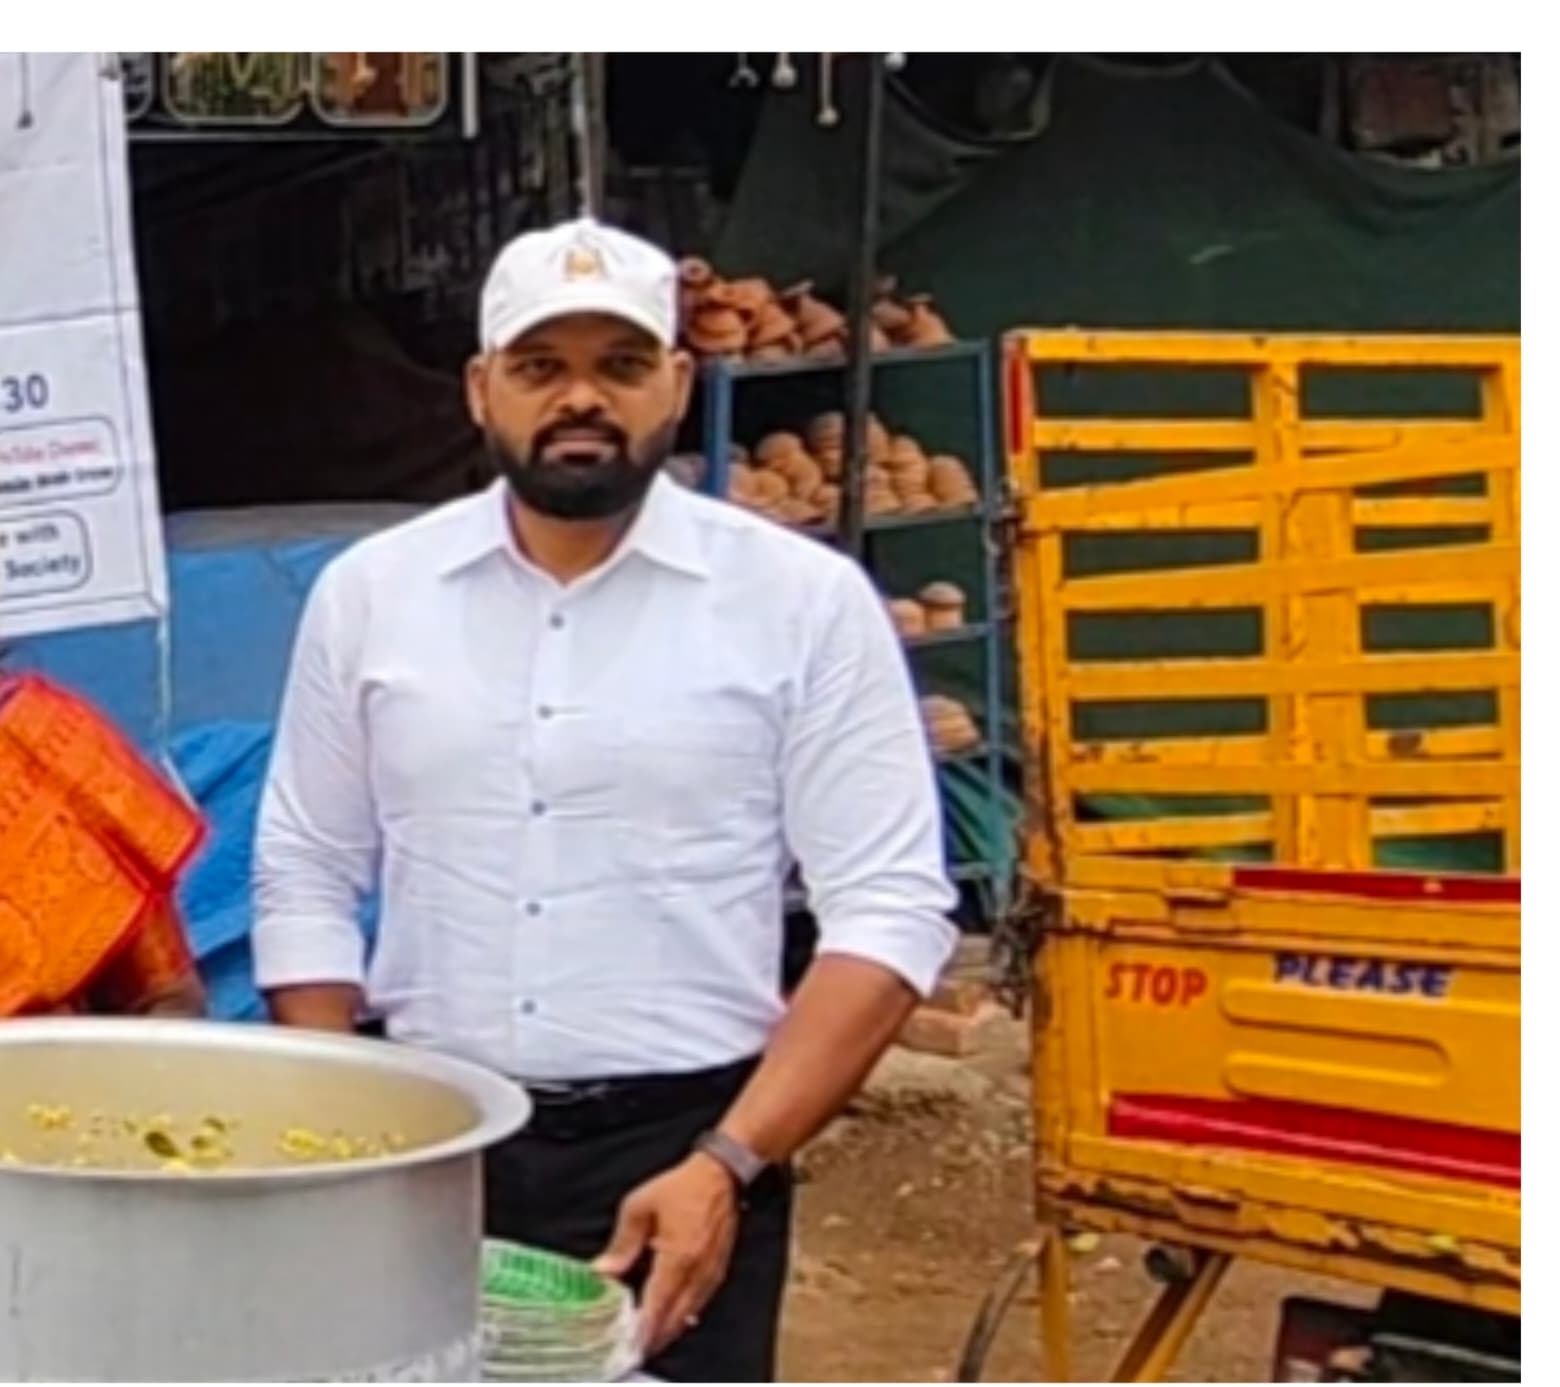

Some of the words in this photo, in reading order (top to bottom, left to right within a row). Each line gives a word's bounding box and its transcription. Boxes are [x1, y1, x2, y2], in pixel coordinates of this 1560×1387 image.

[5, 554, 81, 581] Society
[1104, 961, 1208, 1006] STOP
[1273, 951, 1452, 997] PLEASE
